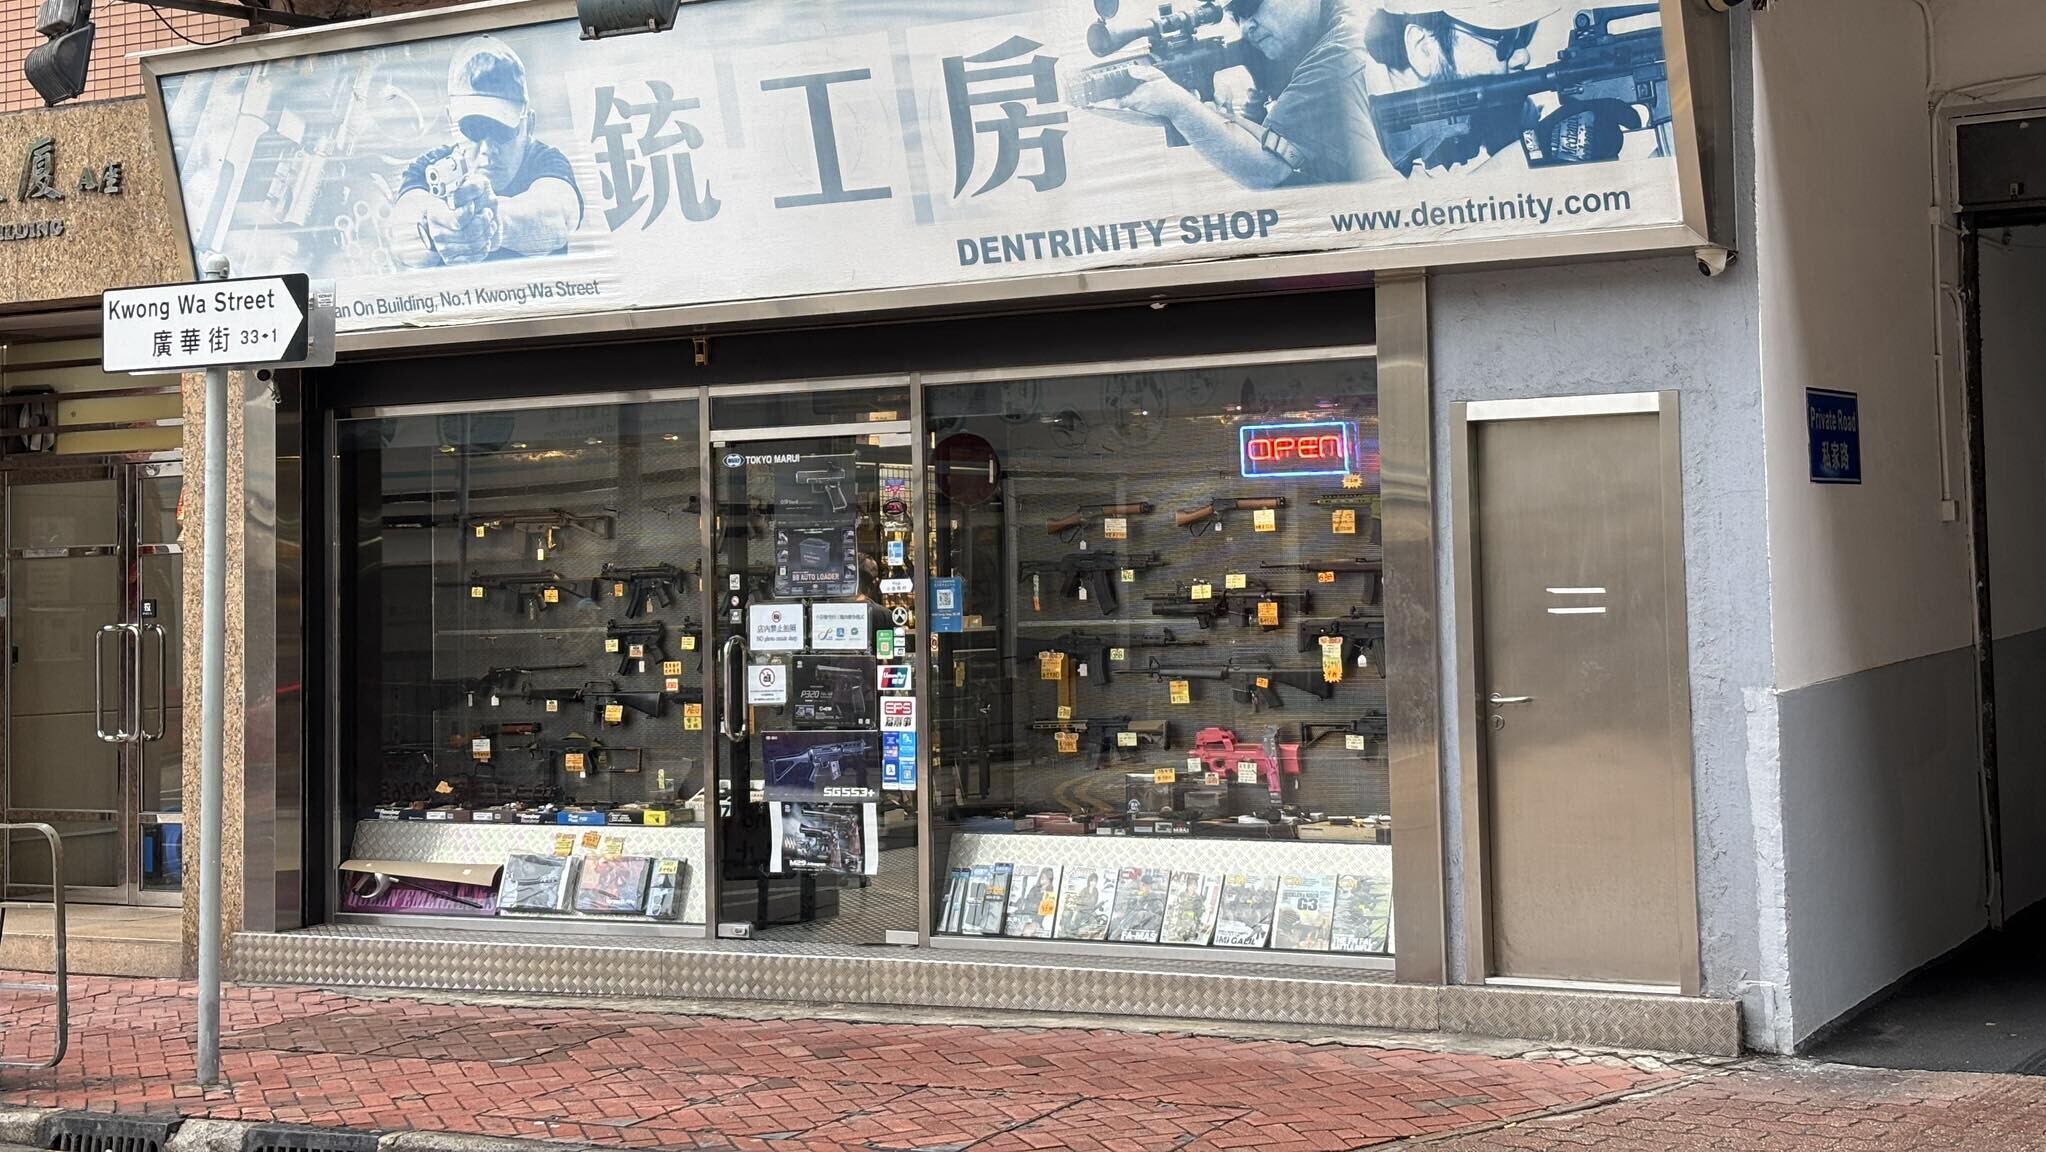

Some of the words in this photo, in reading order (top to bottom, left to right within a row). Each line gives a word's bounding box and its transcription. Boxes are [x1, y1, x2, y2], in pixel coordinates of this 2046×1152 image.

[591, 35, 1069, 232] 銃工房
[1331, 189, 1631, 232] www.dentrinity.com
[957, 218, 1167, 266] DENTRINITY
[1179, 208, 1279, 244] SHOP
[109, 299, 170, 320] Kwong
[177, 294, 206, 315] Wa
[214, 288, 275, 312] Street
[354, 300, 374, 317] On
[377, 295, 438, 314] Building,
[440, 290, 471, 307] No.1
[475, 286, 527, 305] Kwong
[528, 283, 553, 298] Wa
[555, 280, 601, 297] Street
[152, 326, 230, 358] 廣華街
[1810, 406, 1837, 431] Private
[1837, 409, 1857, 433] Road
[745, 455, 772, 465] TOKYO
[774, 453, 801, 463] MARUI
[1248, 434, 1343, 461] OPEN
[1822, 441, 1850, 471] 私家路
[800, 573, 816, 581] AUTO
[816, 572, 840, 581] LOADER
[885, 701, 912, 715] EPS
[1297, 898, 1318, 911] G3
[1120, 931, 1158, 943] FA-MAS
